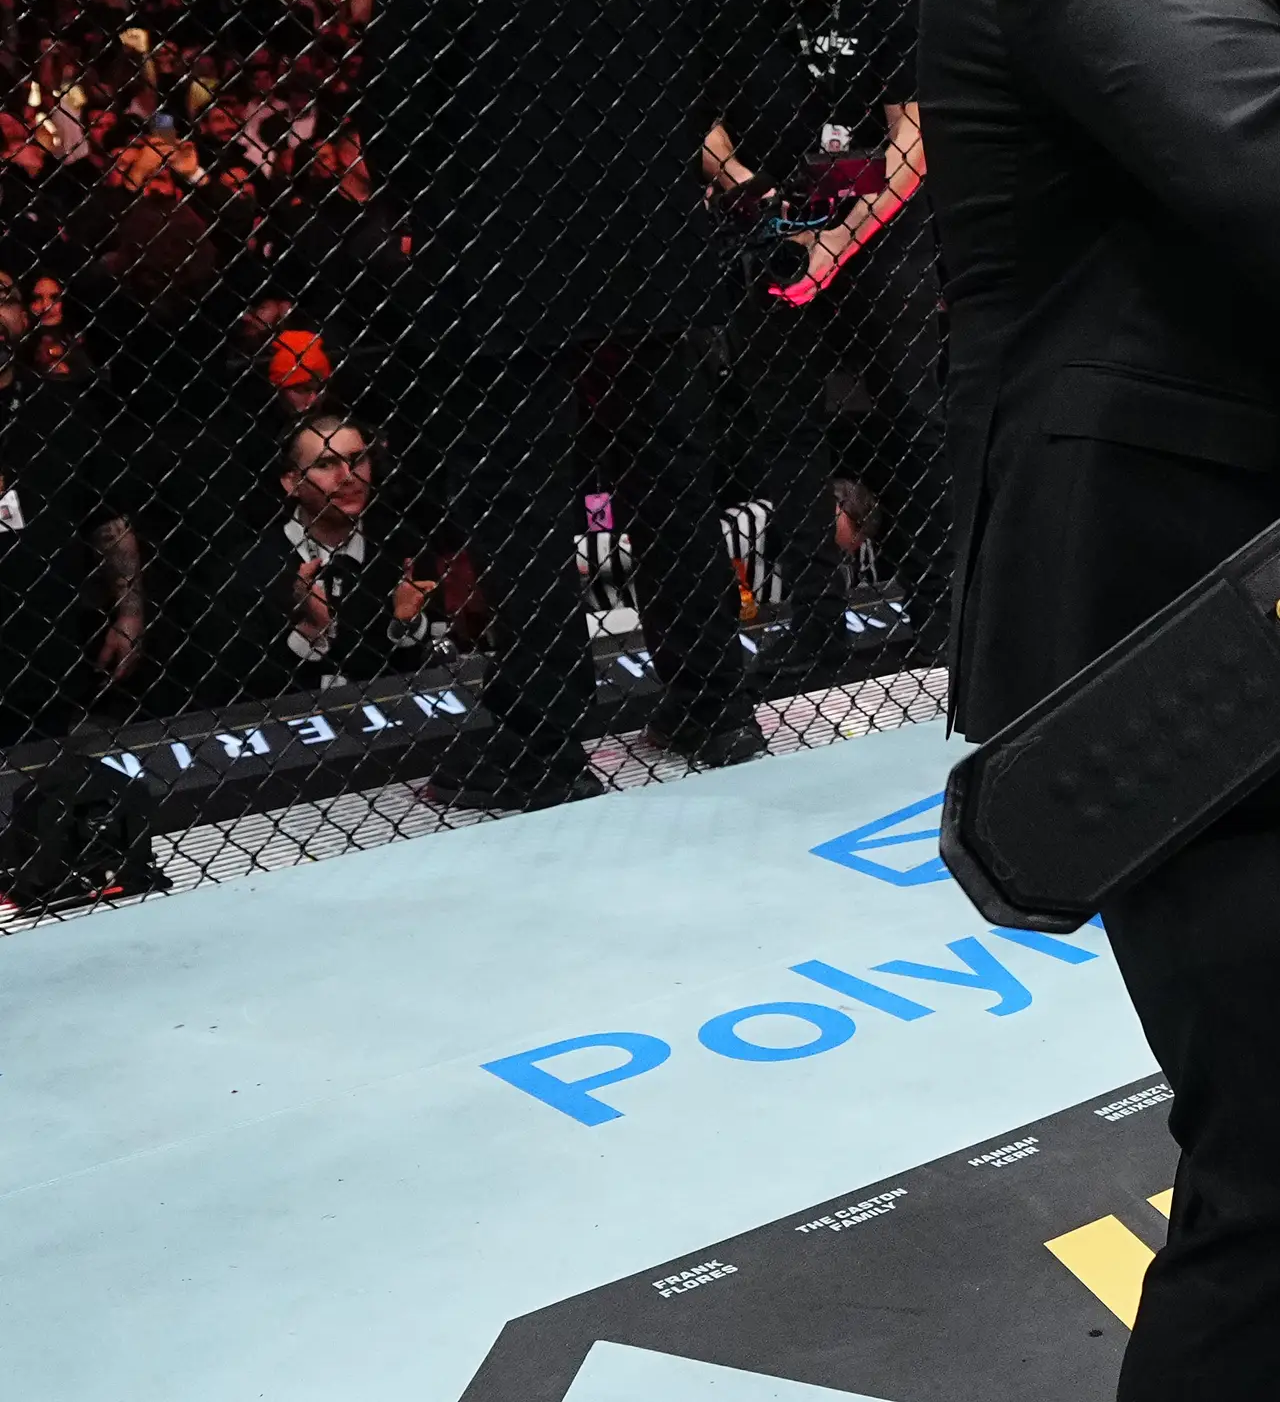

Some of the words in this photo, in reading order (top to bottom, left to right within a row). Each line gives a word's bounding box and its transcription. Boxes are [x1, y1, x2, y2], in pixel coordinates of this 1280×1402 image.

[967, 1136, 1040, 1168] HANNAH
[993, 1145, 1041, 1169] KERR
[795, 1213, 837, 1235] THE
[832, 1188, 910, 1222] CASTON
[829, 1201, 899, 1233] FAMILY
[652, 1258, 724, 1291] FRANK
[658, 1263, 740, 1299] FLORES
